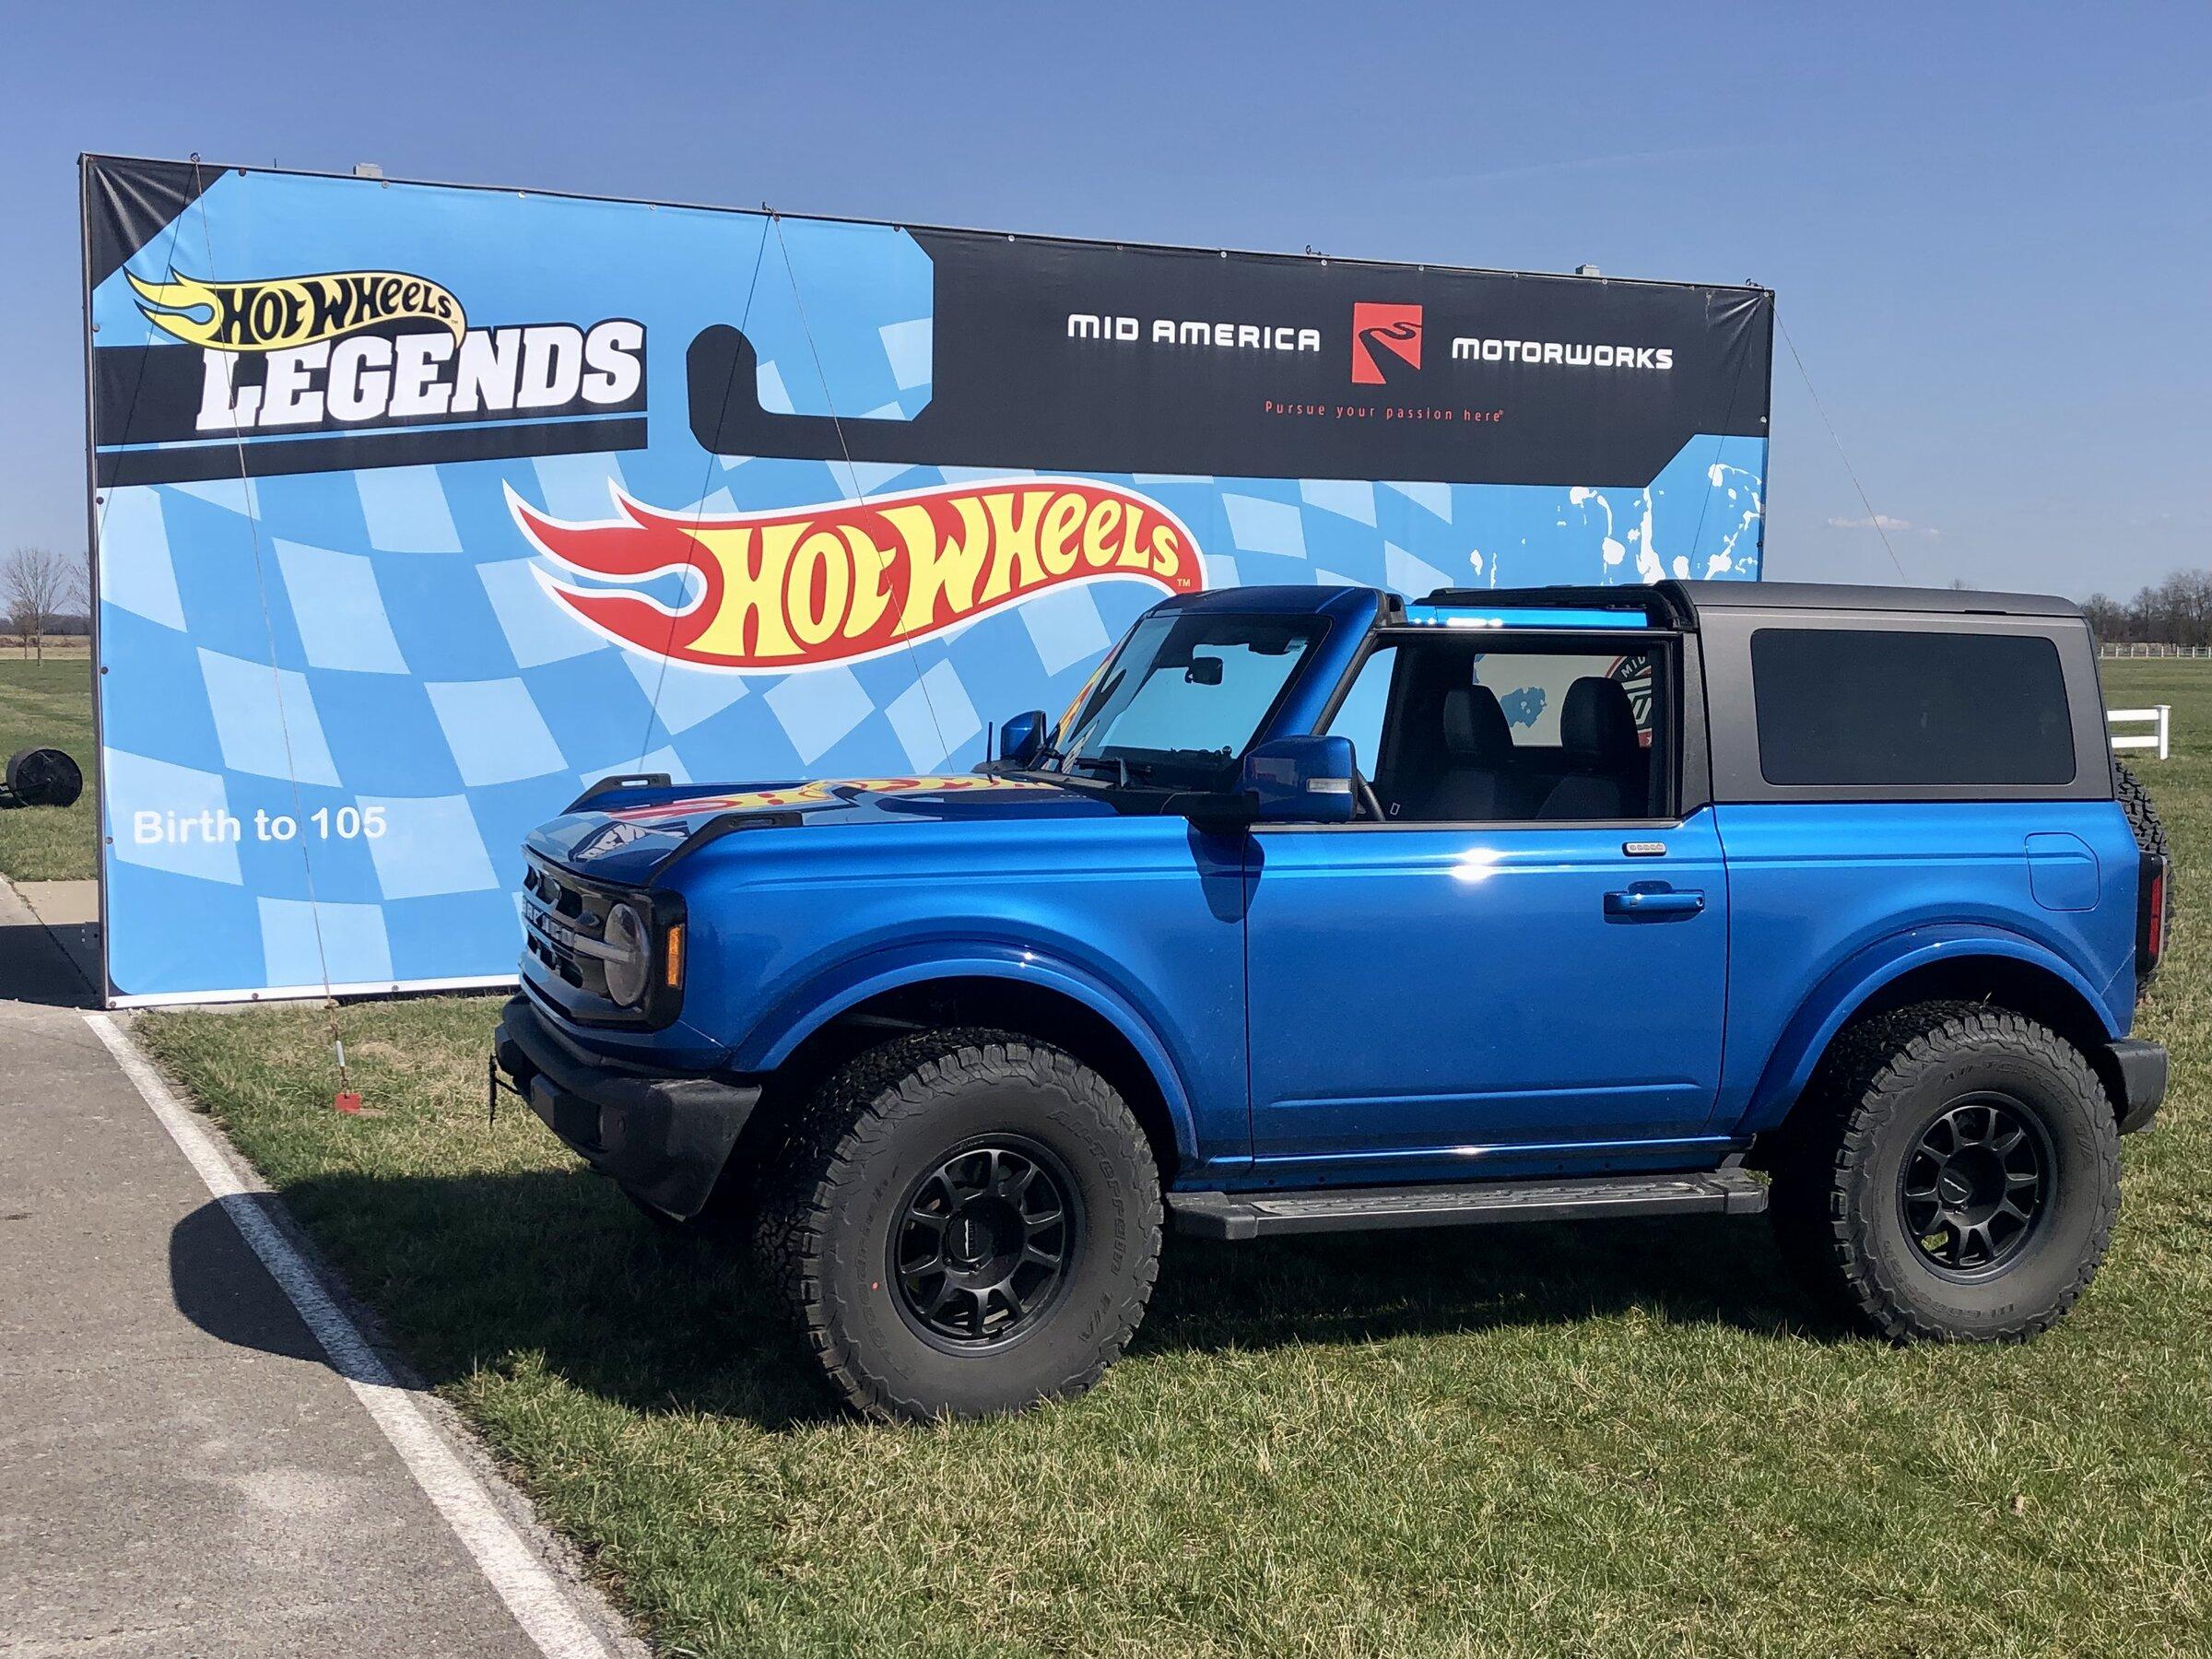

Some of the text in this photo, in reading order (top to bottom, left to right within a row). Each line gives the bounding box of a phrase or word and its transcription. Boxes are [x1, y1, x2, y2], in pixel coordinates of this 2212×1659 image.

[1067, 313, 1321, 352] MID AMERICA
[1452, 337, 1674, 370] MOTORWORKS
[195, 320, 643, 431] LEGENDS
[1265, 400, 1325, 416] Pursue
[1336, 405, 1375, 418] your
[1386, 406, 1453, 420] passion
[134, 806, 386, 844] Birth to 105
